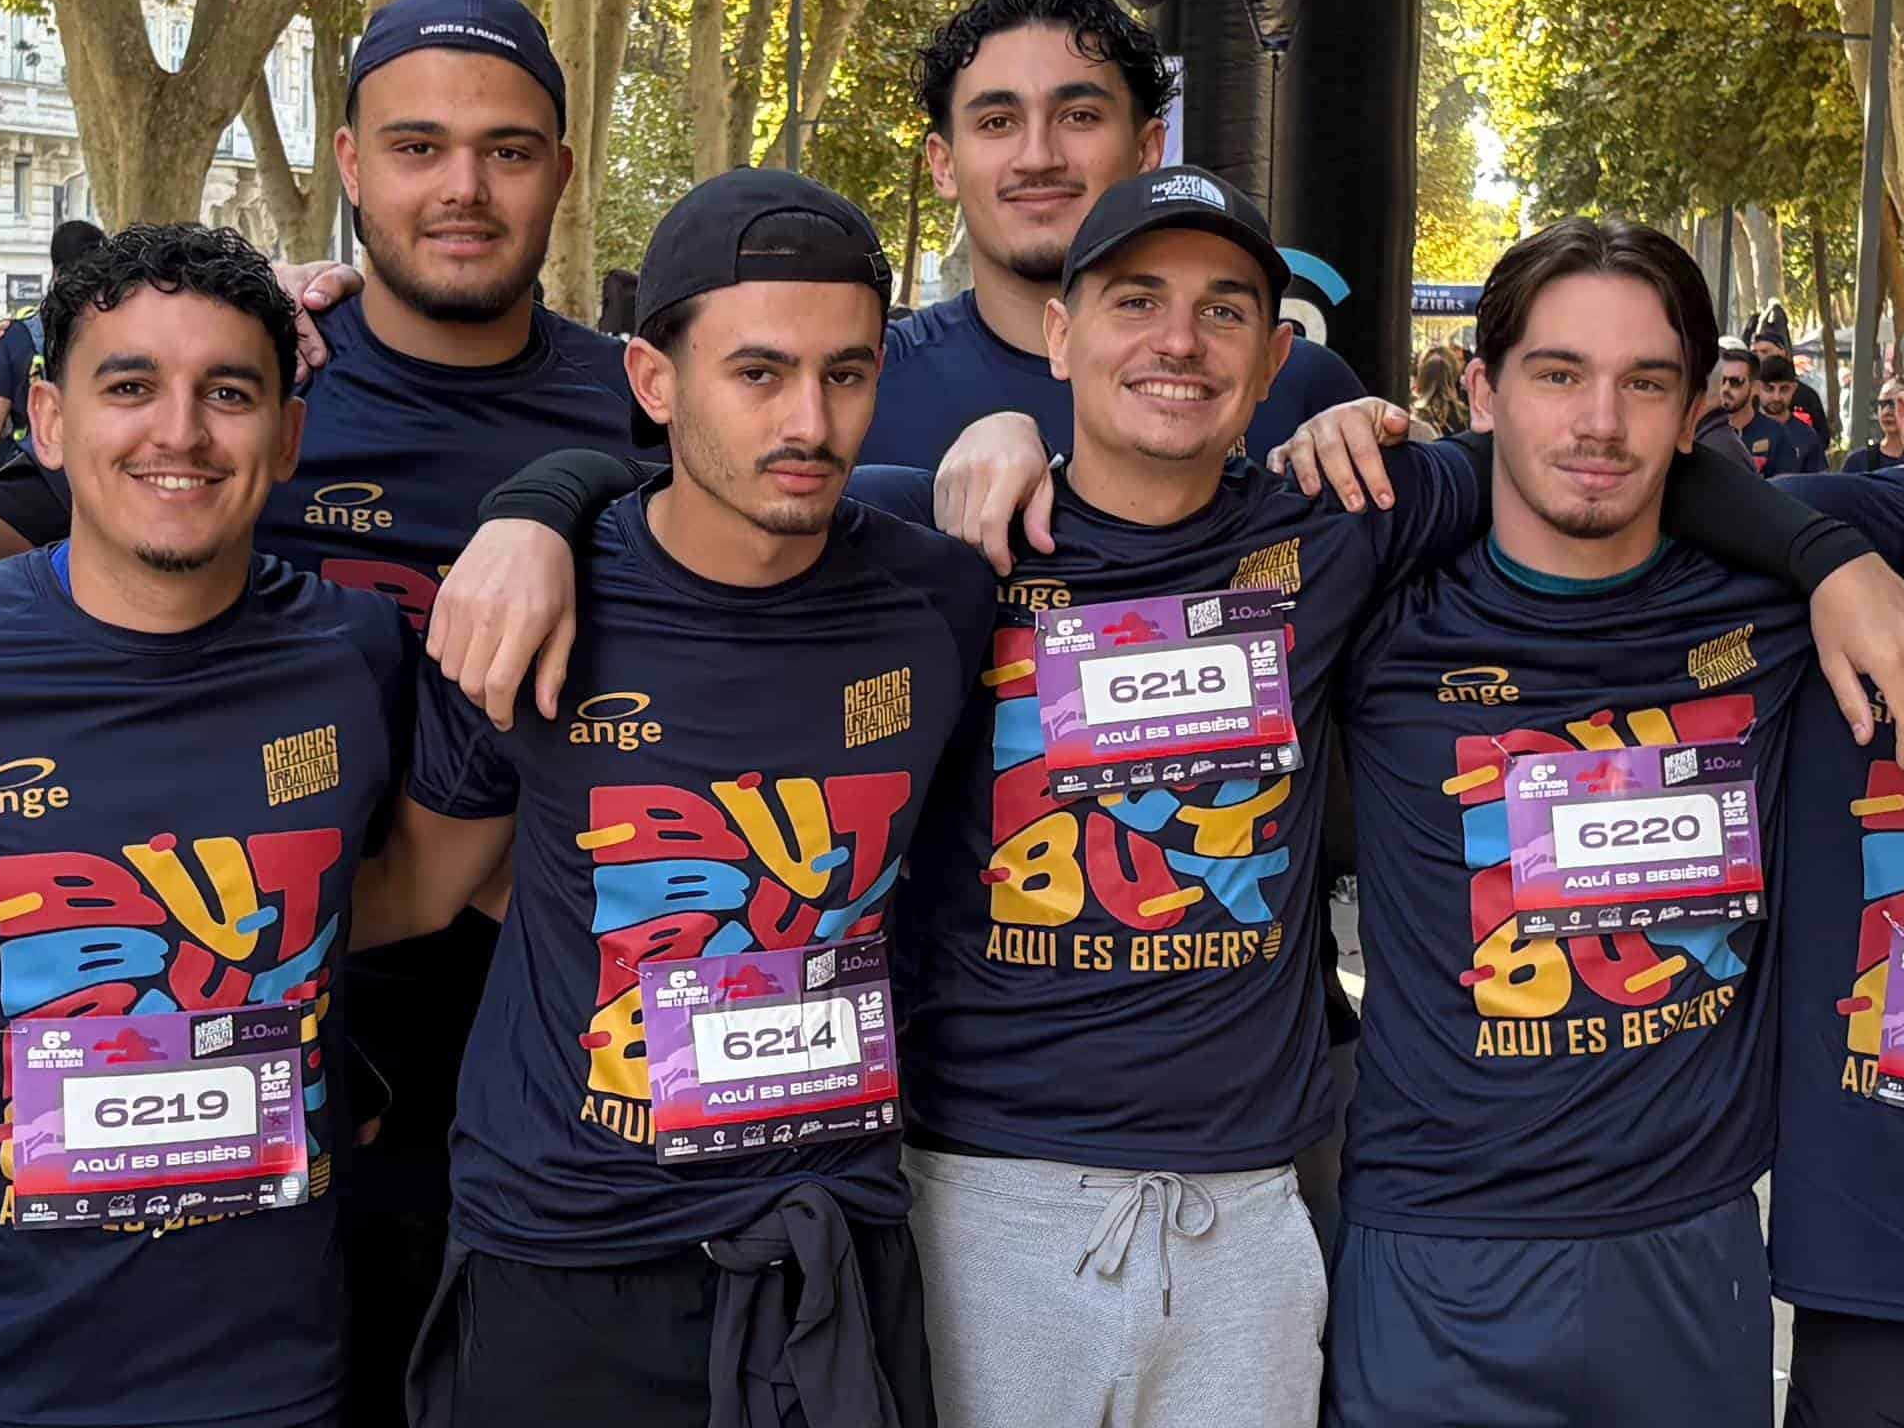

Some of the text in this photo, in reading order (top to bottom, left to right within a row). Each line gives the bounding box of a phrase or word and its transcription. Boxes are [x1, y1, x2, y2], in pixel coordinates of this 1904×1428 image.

[304, 505, 393, 532] ange
[1249, 640, 1277, 659] 12
[1109, 665, 1226, 704] 6218
[1437, 683, 1520, 706] ange
[569, 718, 662, 752] ange
[1096, 726, 1140, 746] AQUÍ
[1146, 726, 1170, 740] ES
[1721, 790, 1747, 809] 12
[1578, 815, 1701, 849] 6220
[1564, 870, 1610, 889] AQUÍ
[1615, 870, 1641, 885] ES
[986, 924, 1259, 972] AQUI ES BESIERS
[858, 991, 883, 1011] 12
[723, 1021, 836, 1061] 6214
[1475, 1020, 1552, 1057] AQUI
[1568, 1018, 1607, 1056] ES
[260, 1061, 291, 1081] 12
[708, 1084, 755, 1105] AQUÍ
[760, 1084, 784, 1099] ES
[95, 1090, 229, 1128] 6219
[72, 1154, 125, 1172] AQUÍ
[131, 1154, 159, 1169] ES
